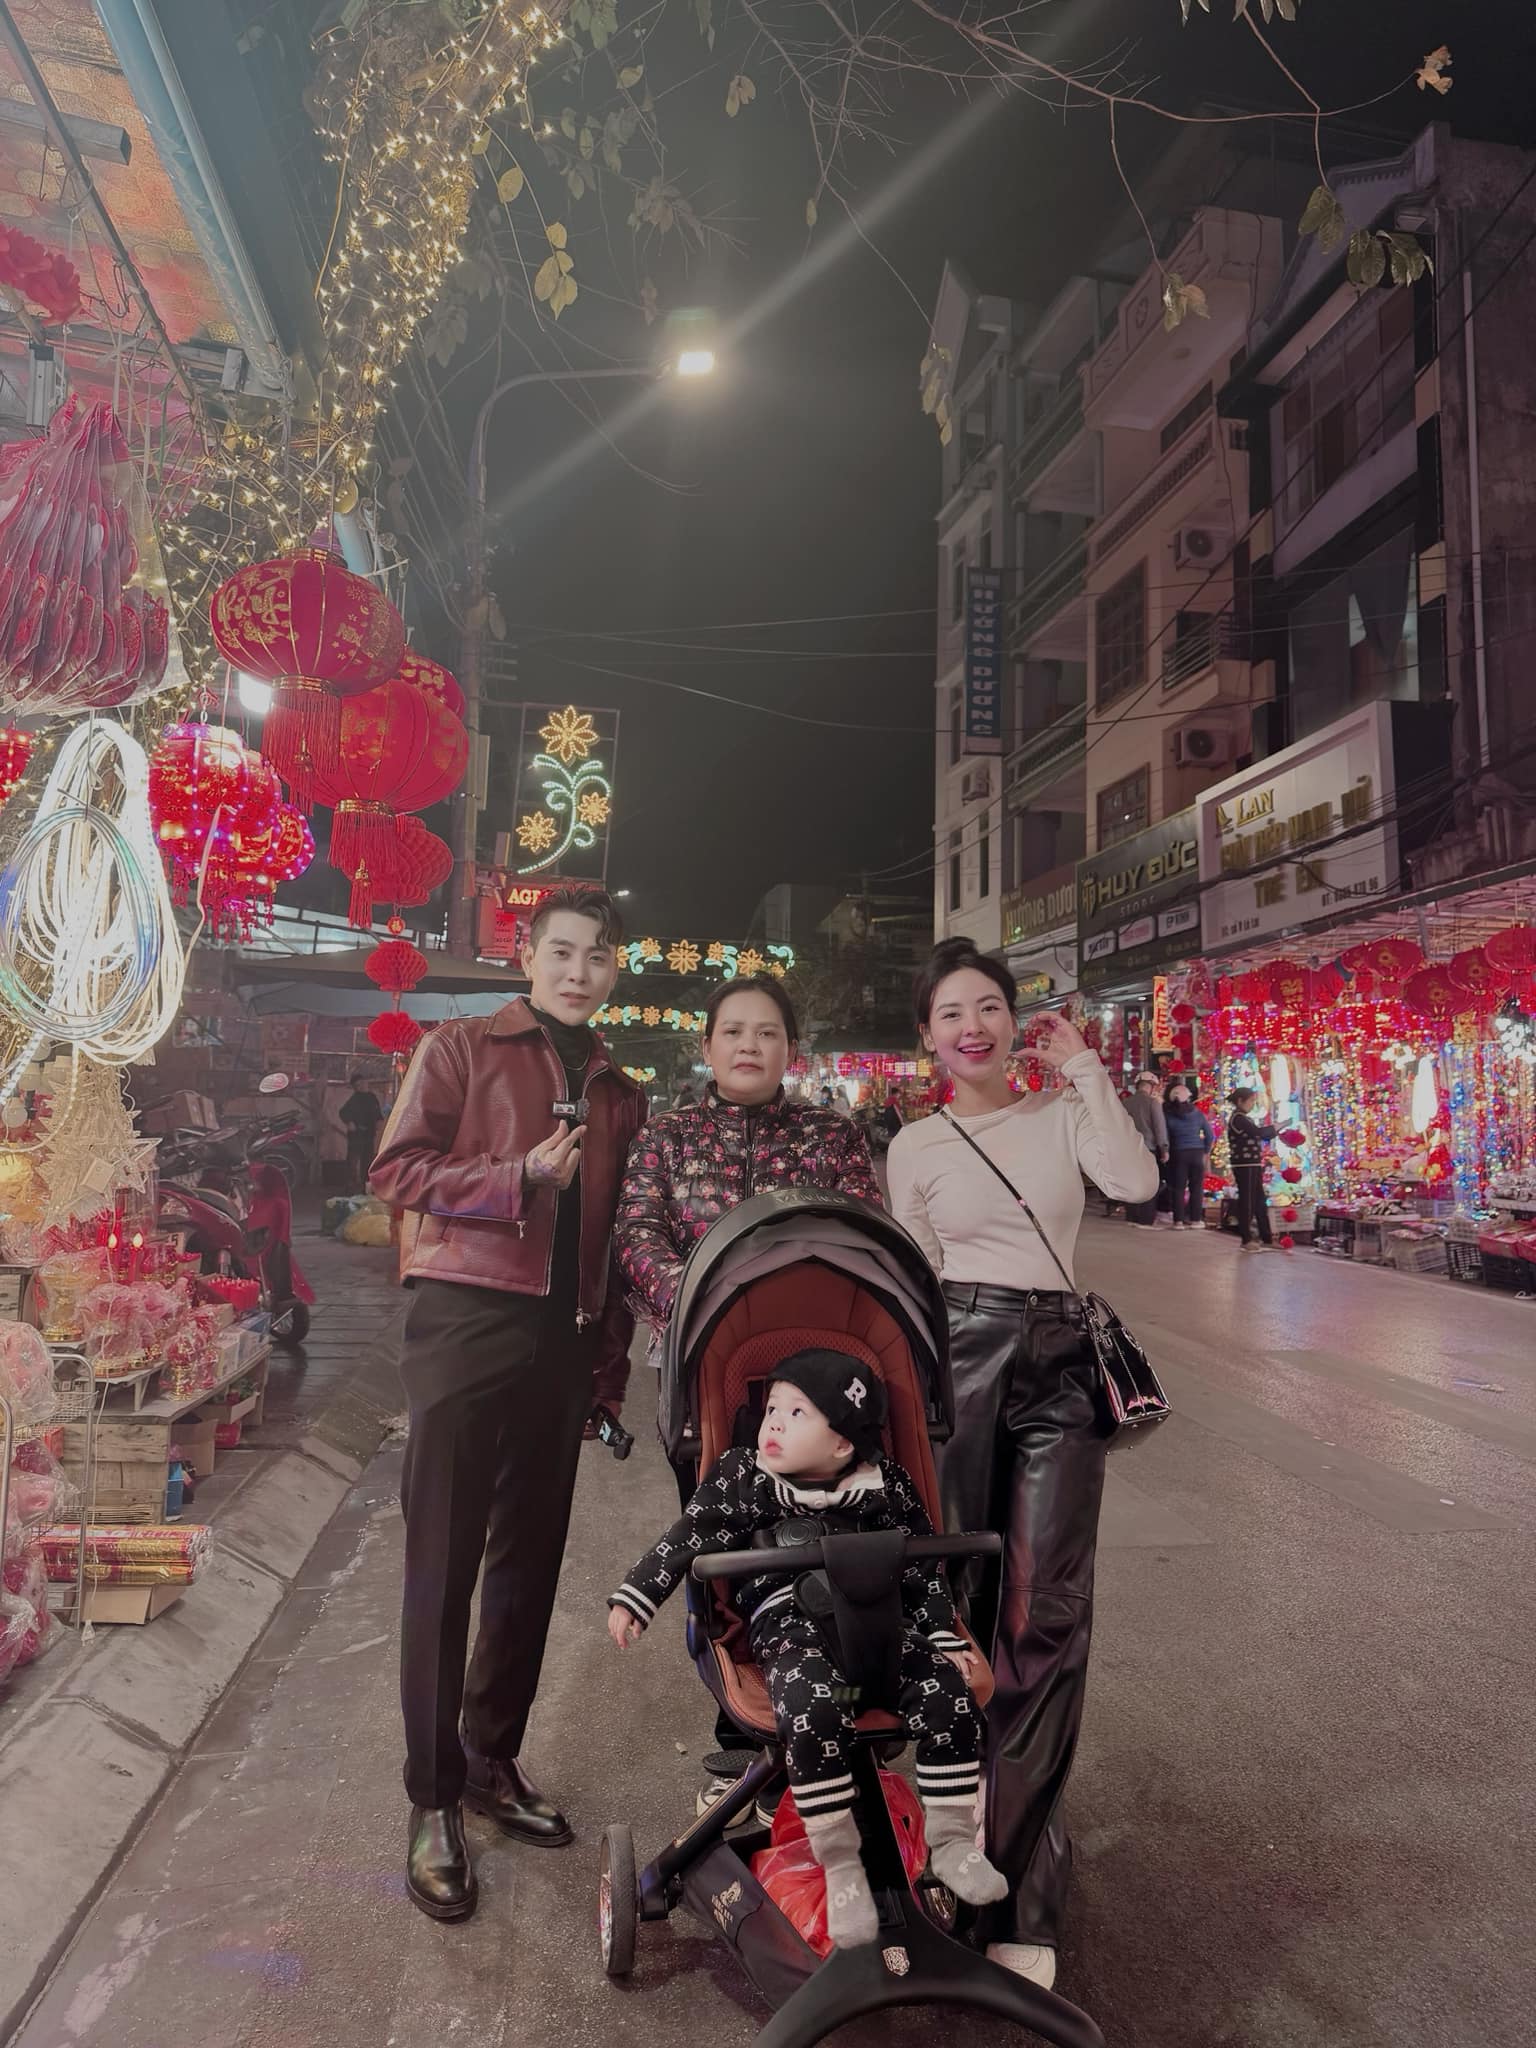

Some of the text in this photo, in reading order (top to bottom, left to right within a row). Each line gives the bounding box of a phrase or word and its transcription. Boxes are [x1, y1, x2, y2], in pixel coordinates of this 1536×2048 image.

[1236, 788, 1275, 827] LAN
[1098, 864, 1144, 905] HUY
[844, 1376, 867, 1409] R
